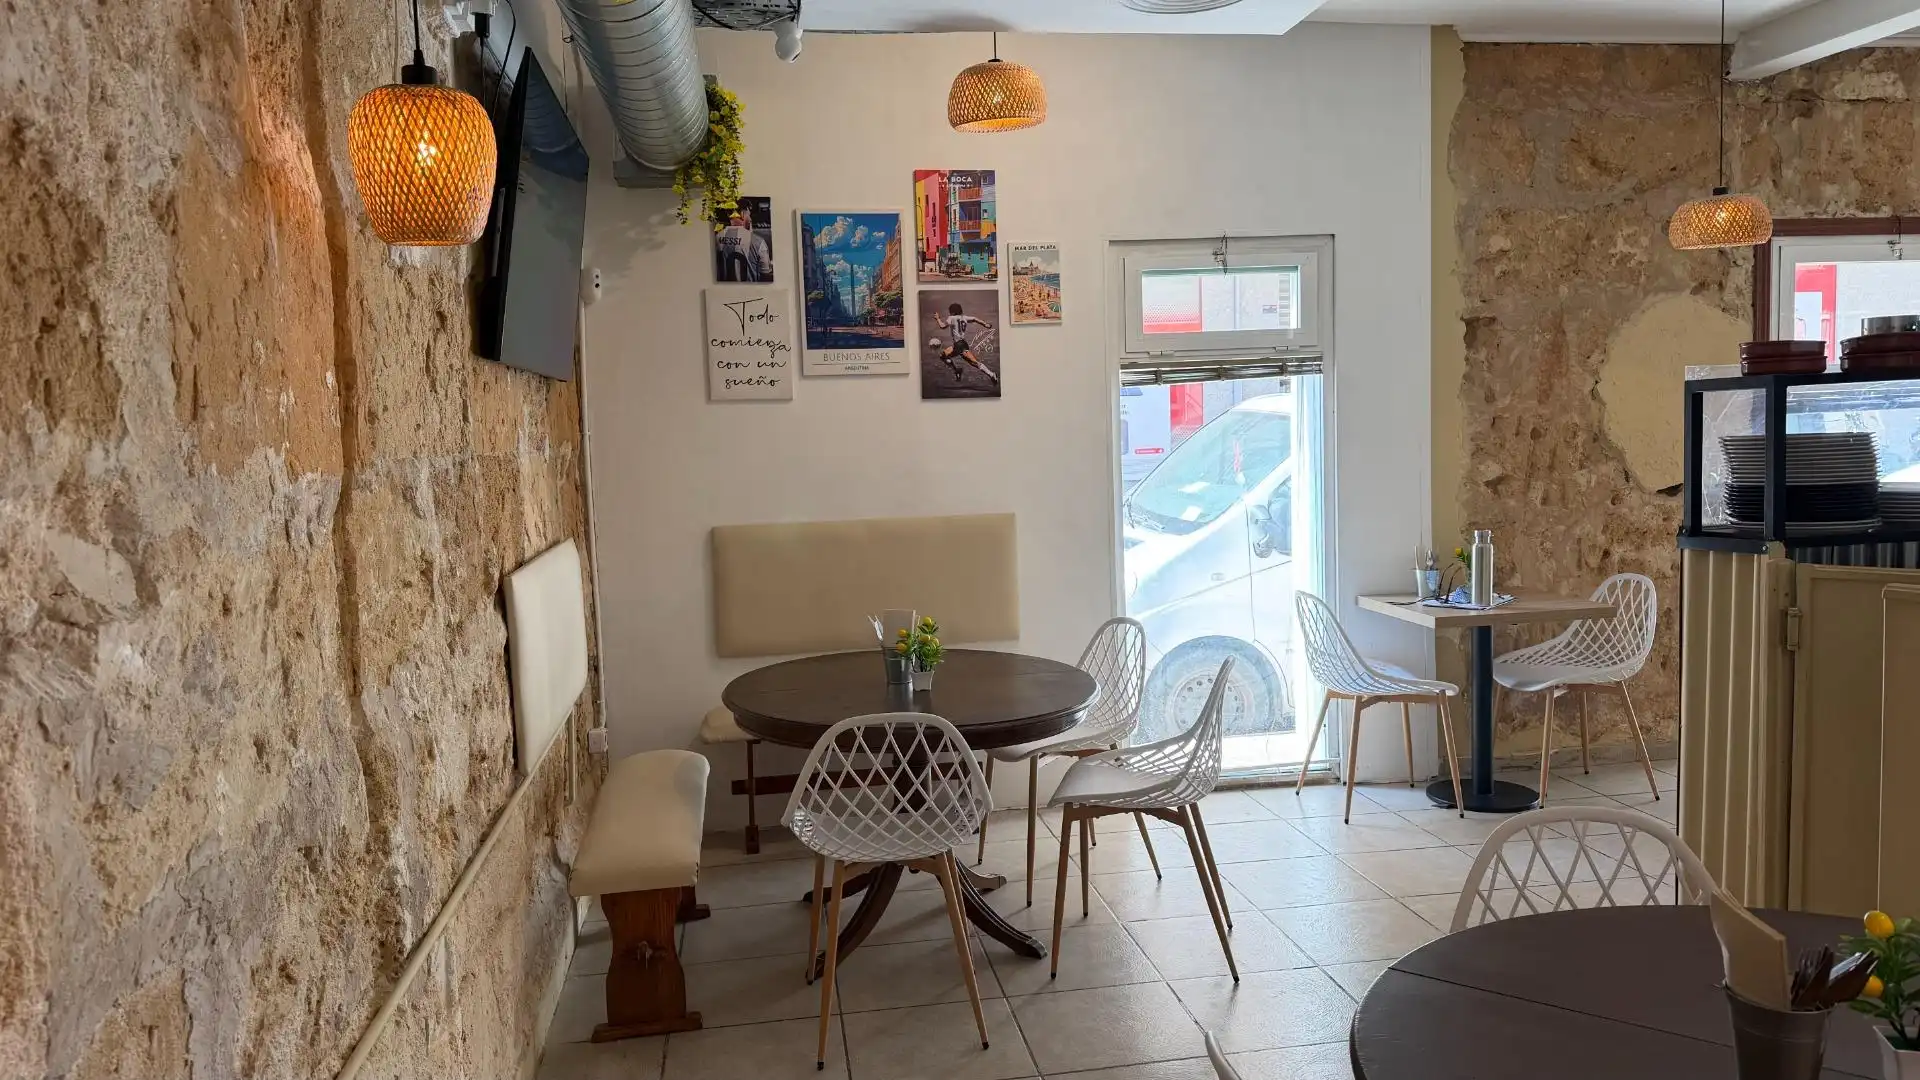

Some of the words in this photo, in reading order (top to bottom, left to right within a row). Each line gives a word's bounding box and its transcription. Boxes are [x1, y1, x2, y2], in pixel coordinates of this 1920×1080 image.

[723, 298, 779, 336] Todo
[957, 319, 967, 333] 10
[823, 352, 862, 362] BUENOS
[865, 352, 890, 361] AIRES
[717, 360, 751, 369] con
[725, 375, 781, 389] sueño
